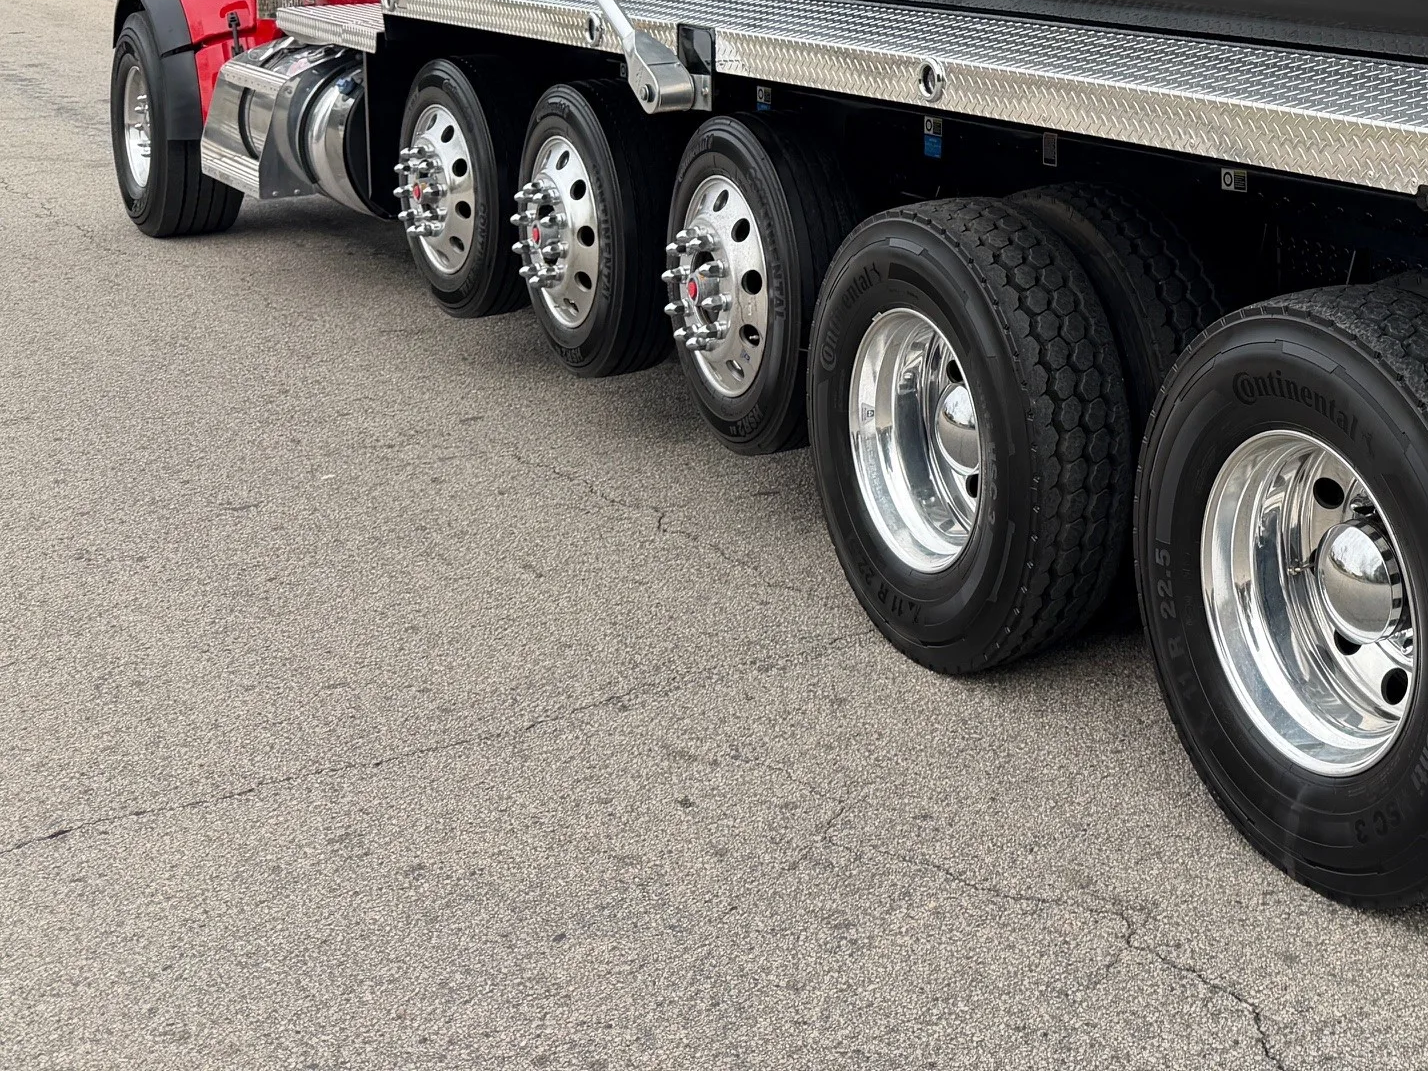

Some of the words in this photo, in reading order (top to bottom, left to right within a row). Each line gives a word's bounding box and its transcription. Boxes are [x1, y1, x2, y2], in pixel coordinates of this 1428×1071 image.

[1232, 370, 1359, 444] Continental
[1155, 547, 1177, 621] 22.5
[1167, 635, 1185, 660] R
[1354, 819, 1368, 845] 3
